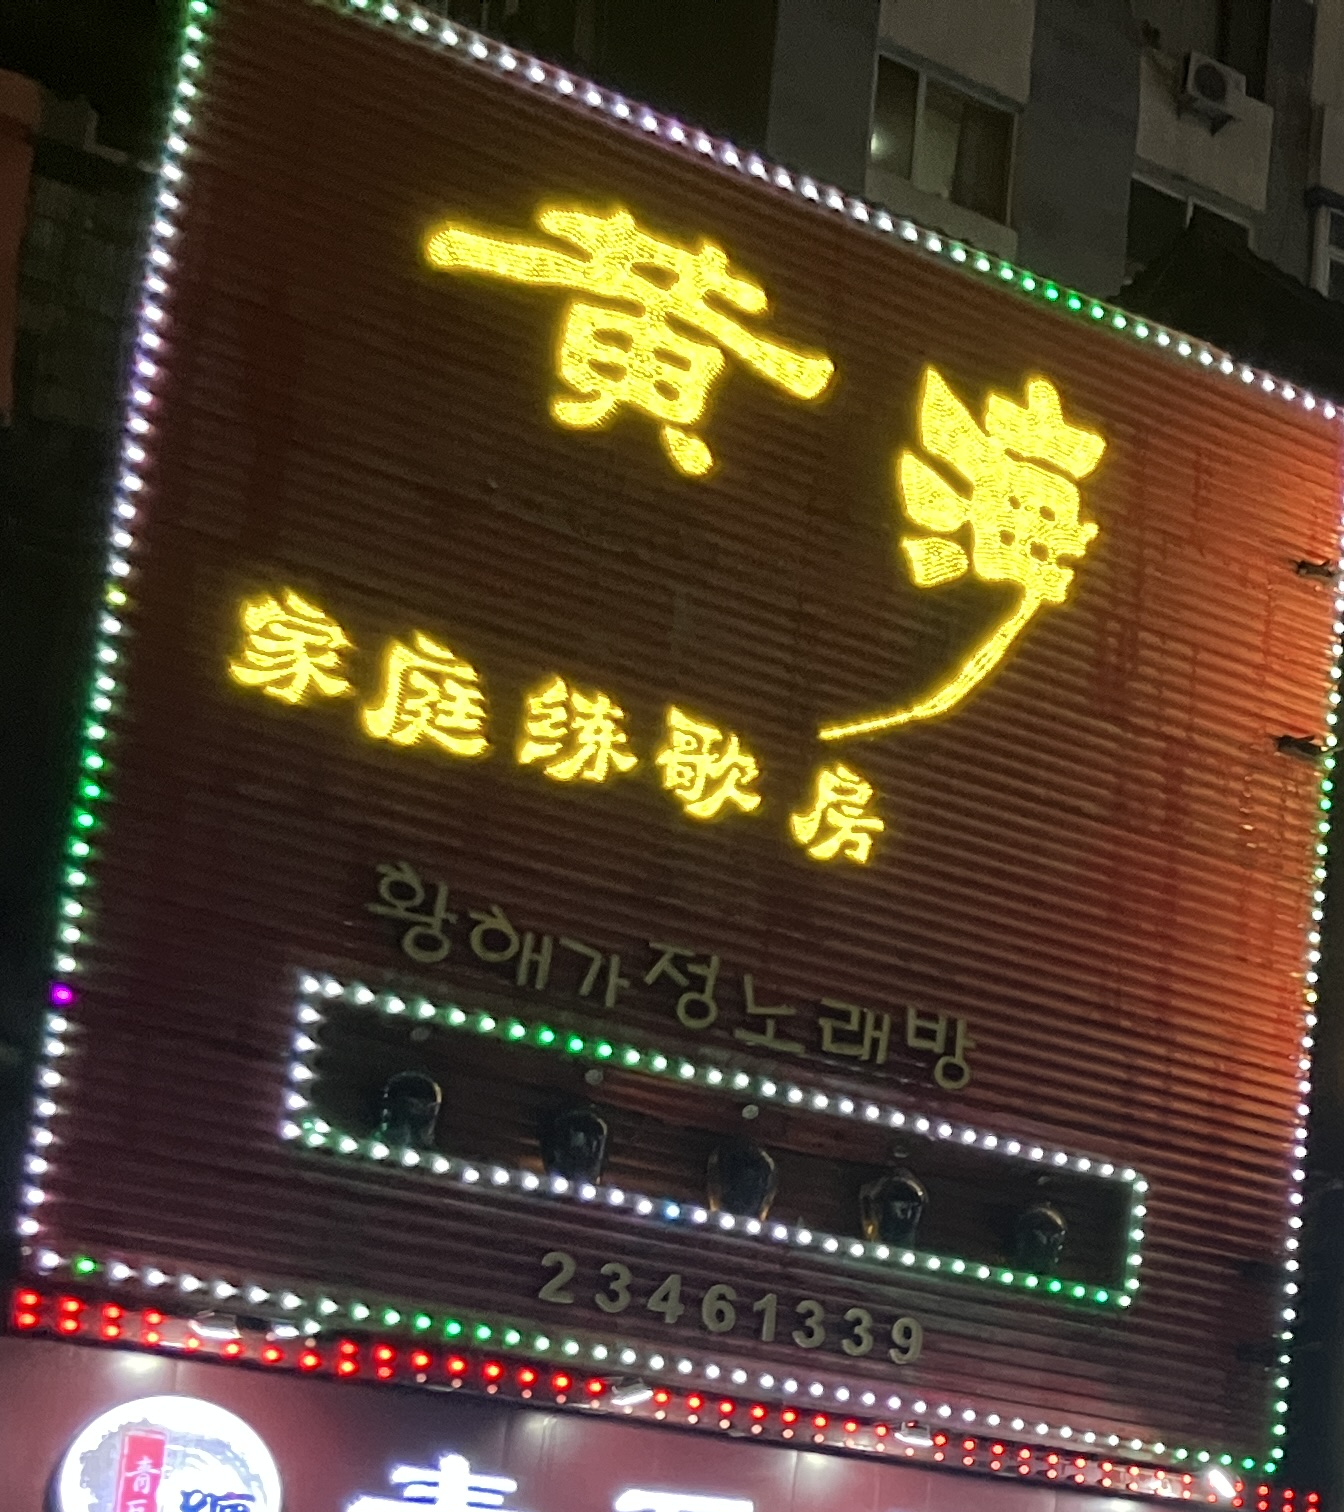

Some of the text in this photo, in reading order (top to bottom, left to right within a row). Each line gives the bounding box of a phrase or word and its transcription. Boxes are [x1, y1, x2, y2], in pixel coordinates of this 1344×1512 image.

[424, 206, 1107, 740] 黄海
[227, 590, 886, 866] 家庭练歌房
[367, 862, 979, 1090] 황해가정노래방
[536, 1251, 925, 1367] 23461339
